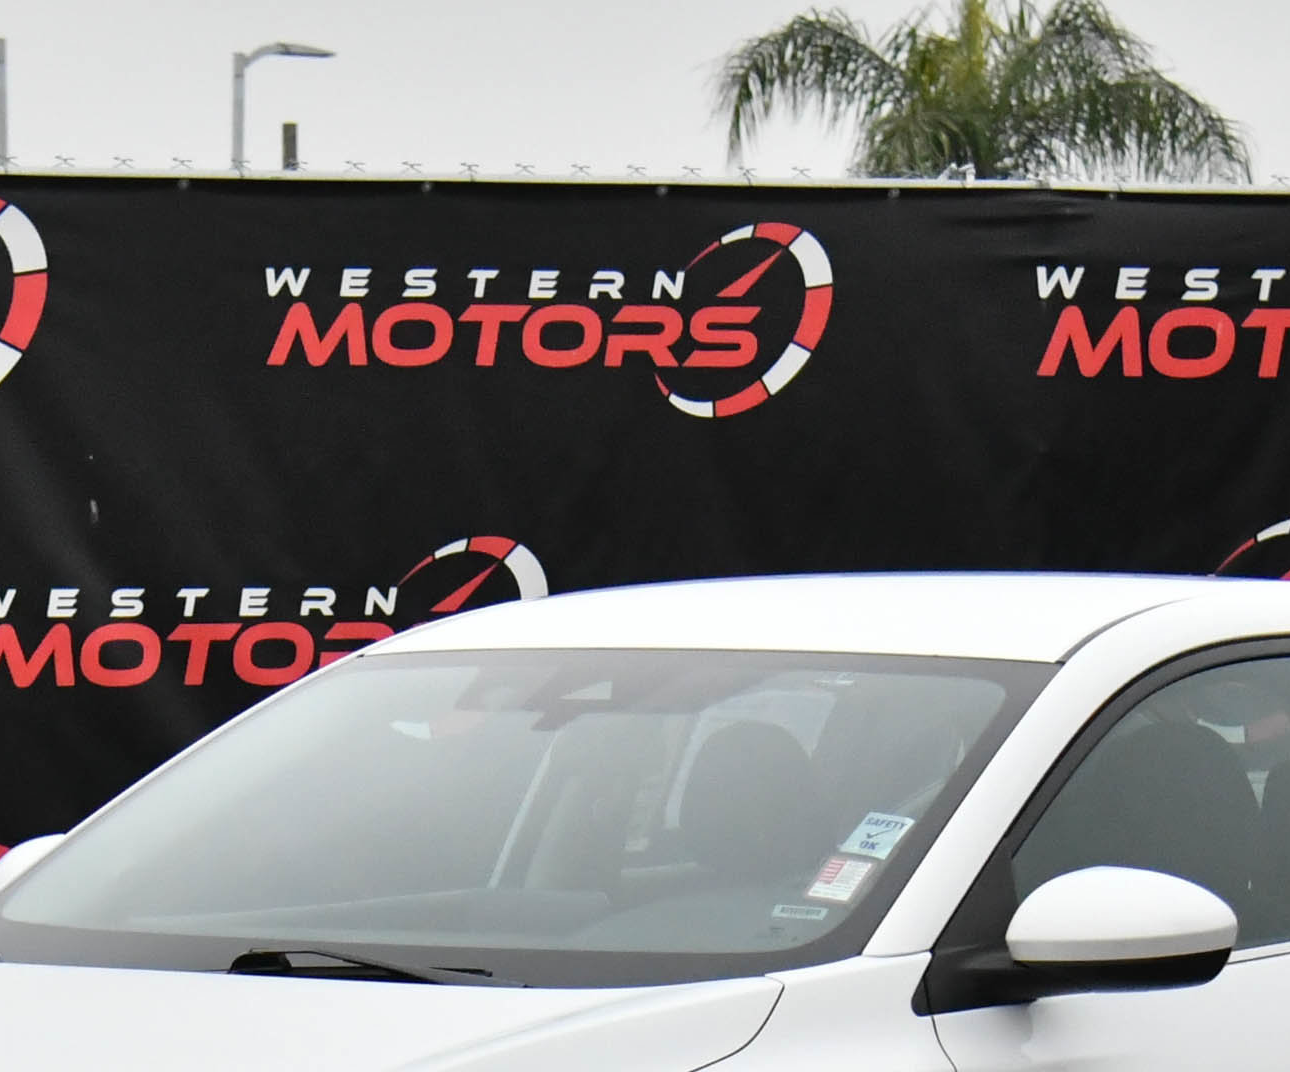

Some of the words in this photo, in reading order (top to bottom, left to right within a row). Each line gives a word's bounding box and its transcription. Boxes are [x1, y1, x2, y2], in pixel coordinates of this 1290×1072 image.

[266, 268, 685, 299] WESTERN
[267, 302, 760, 368] MOTORS
[864, 817, 907, 830] SAFETY
[859, 840, 881, 851] OK
